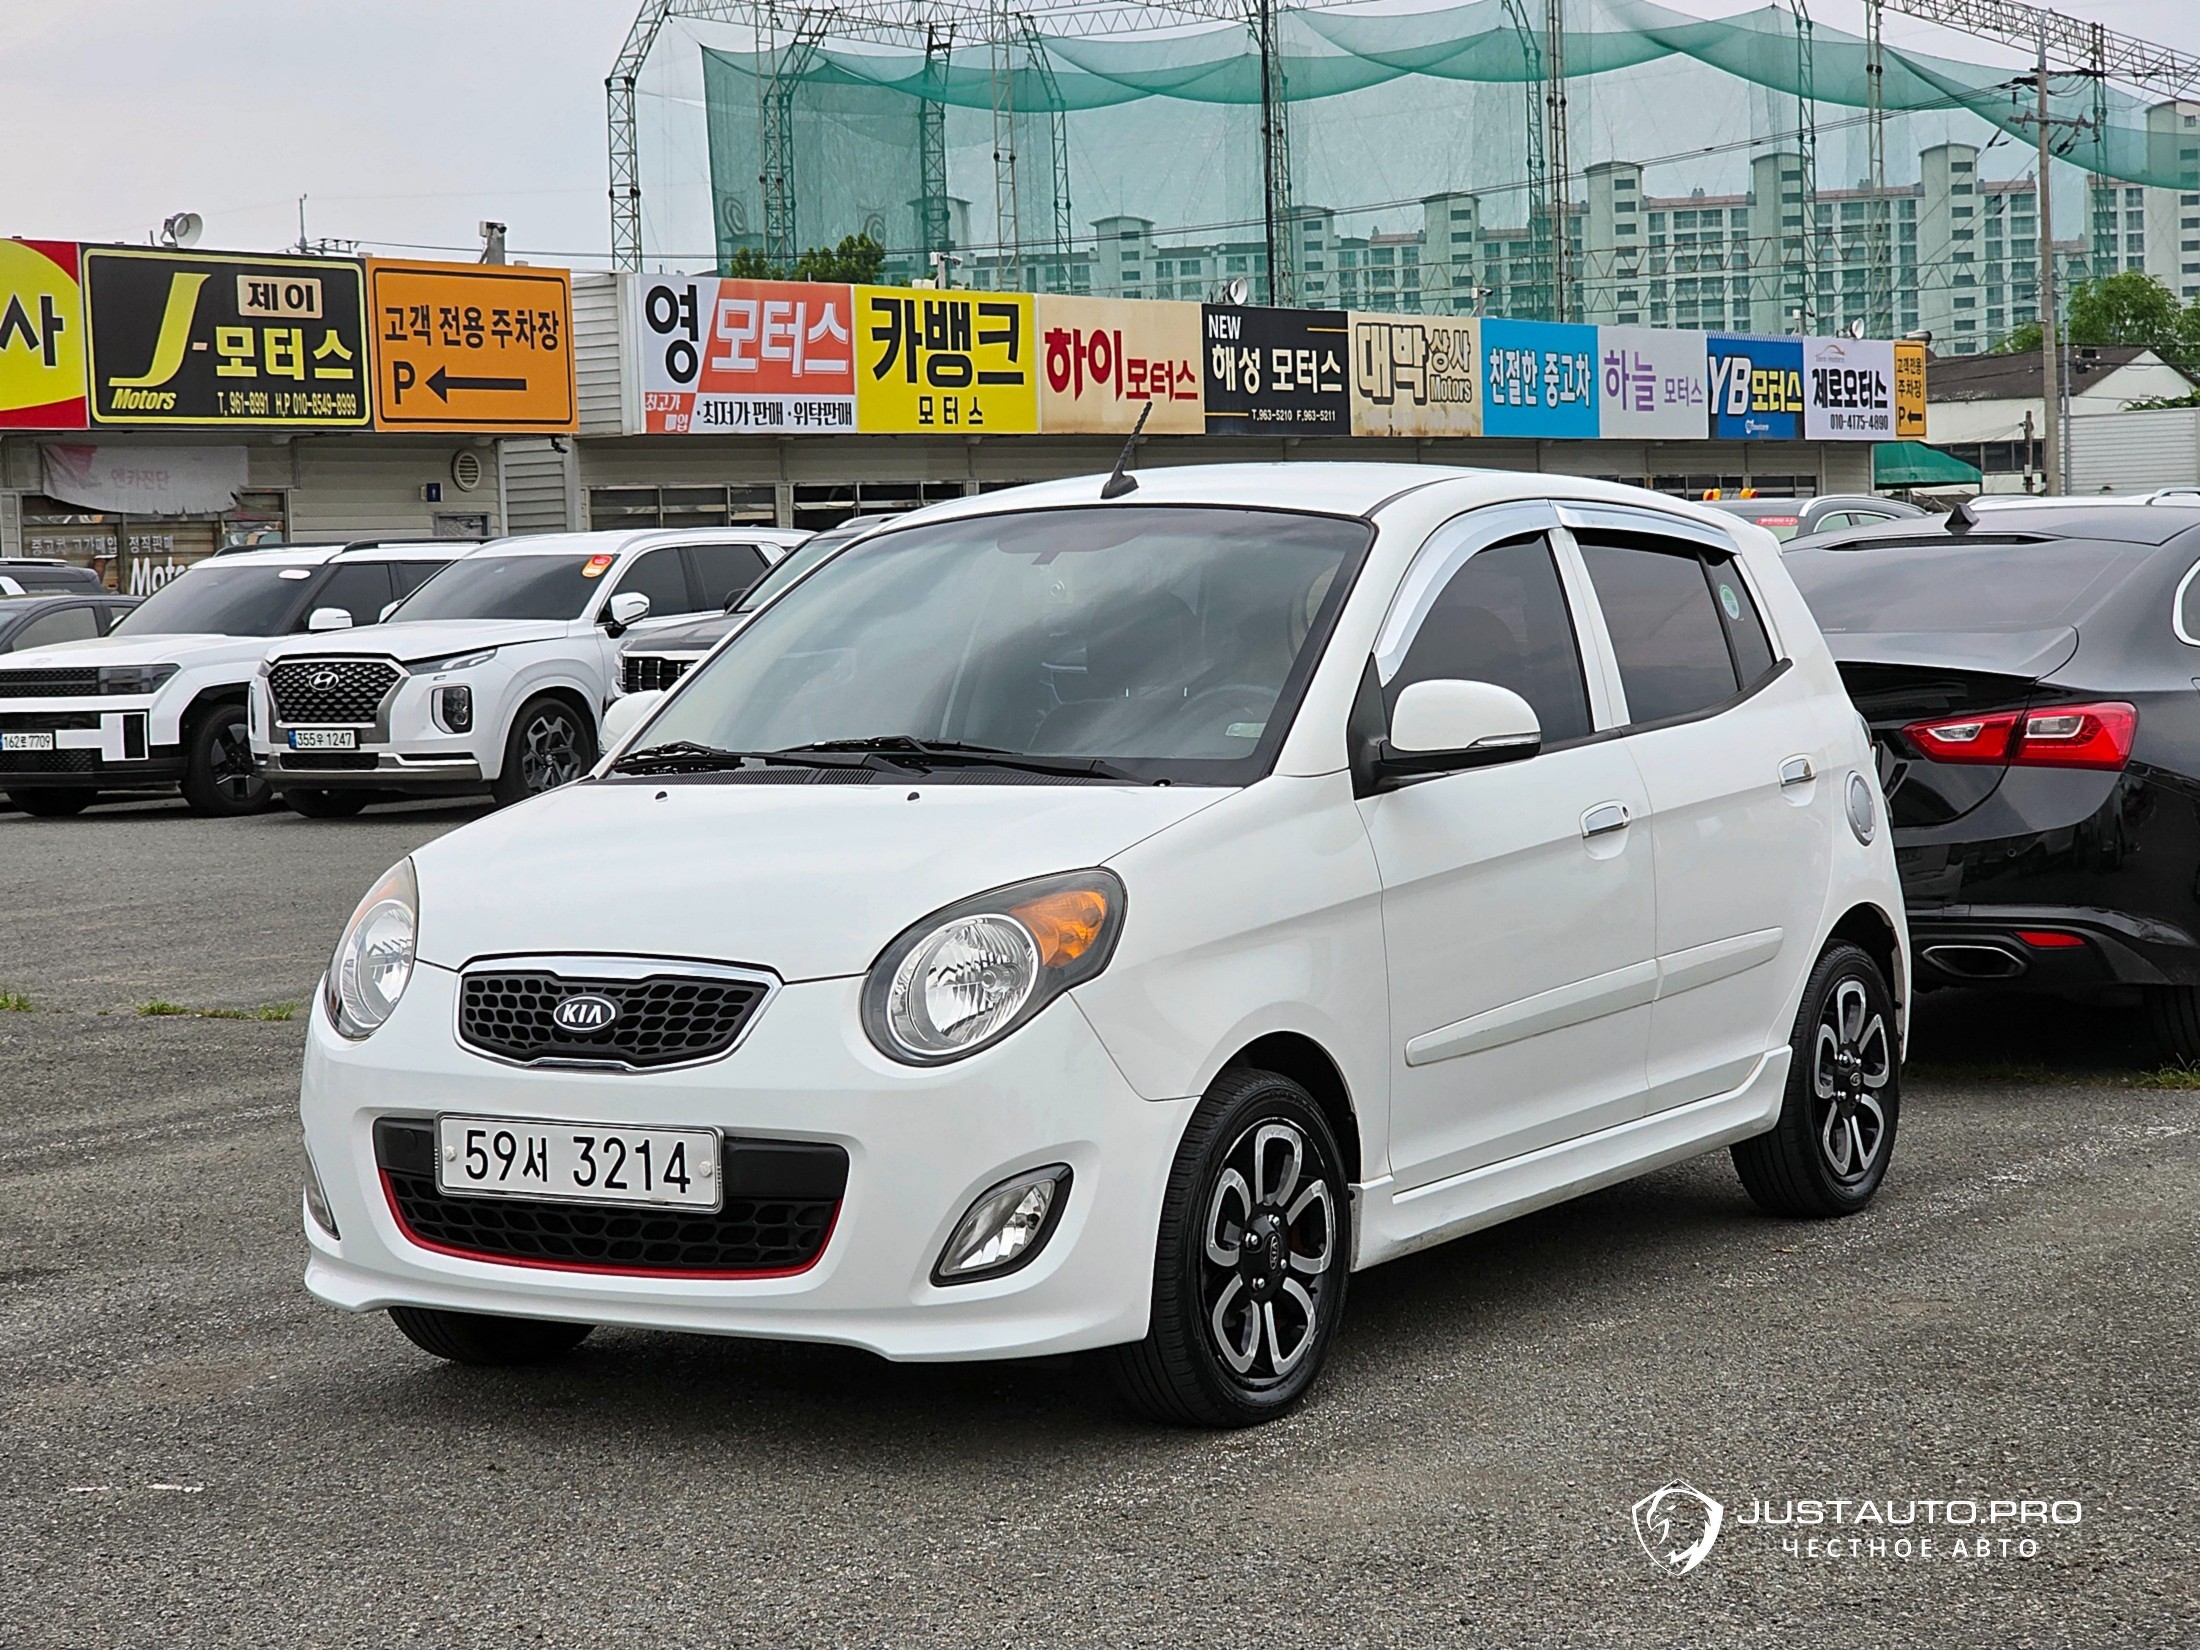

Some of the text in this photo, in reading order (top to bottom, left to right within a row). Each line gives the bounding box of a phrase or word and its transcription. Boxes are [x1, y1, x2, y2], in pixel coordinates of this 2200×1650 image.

[246, 282, 315, 312] 제이
[384, 305, 560, 351] 고객 전용 주차장
[645, 284, 850, 384] 영 모터스
[1208, 314, 1241, 340] NEW
[871, 298, 1025, 389] 카뱅크
[1212, 344, 1342, 394] 해성 모터스
[1356, 322, 1471, 405] 대박 상사
[1489, 347, 1591, 408] 친절한 중고차
[393, 361, 416, 405] P
[1429, 374, 1472, 403] Motors
[1604, 350, 1703, 412] 하늘 모터스
[1812, 368, 1888, 409] 제로모터스
[1897, 379, 1922, 398] 주차장
[111, 388, 177, 410] Motors
[918, 396, 984, 425] 모터스
[752, 402, 783, 426] 판매
[1830, 414, 1888, 430] 010-4175-4890
[1898, 406, 1906, 427] P
[29, 735, 51, 748] 7709
[326, 733, 352, 748] 1247
[562, 1004, 602, 1025] KIA
[465, 1129, 691, 1194] 59서 3214
